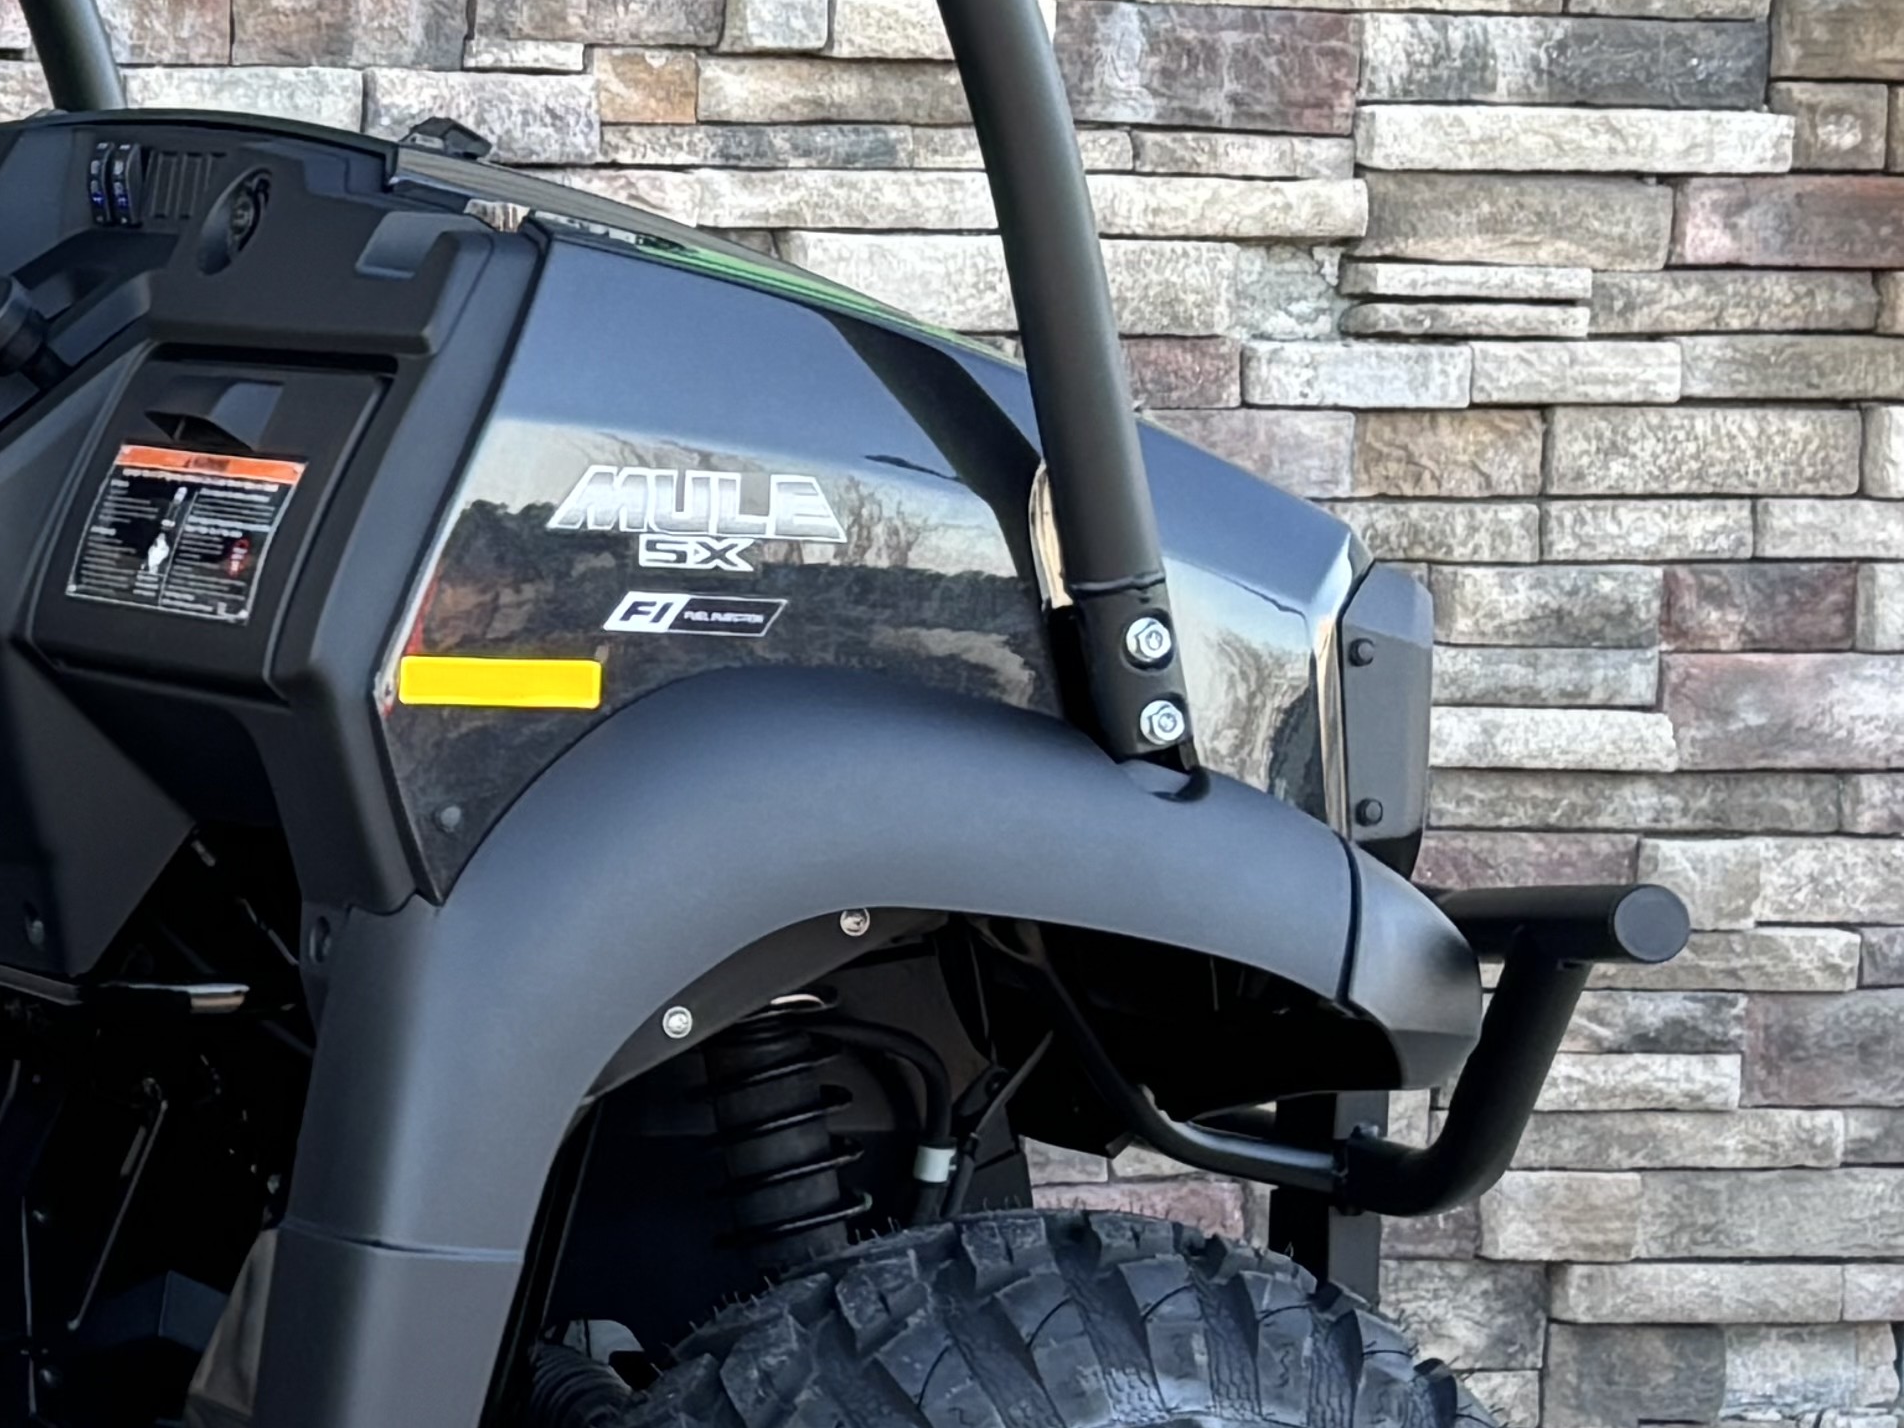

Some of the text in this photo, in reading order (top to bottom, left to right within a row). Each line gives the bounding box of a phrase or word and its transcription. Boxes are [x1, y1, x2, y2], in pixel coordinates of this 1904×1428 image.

[546, 465, 847, 542] MULE
[640, 534, 754, 571] SX
[618, 600, 675, 624] FI
